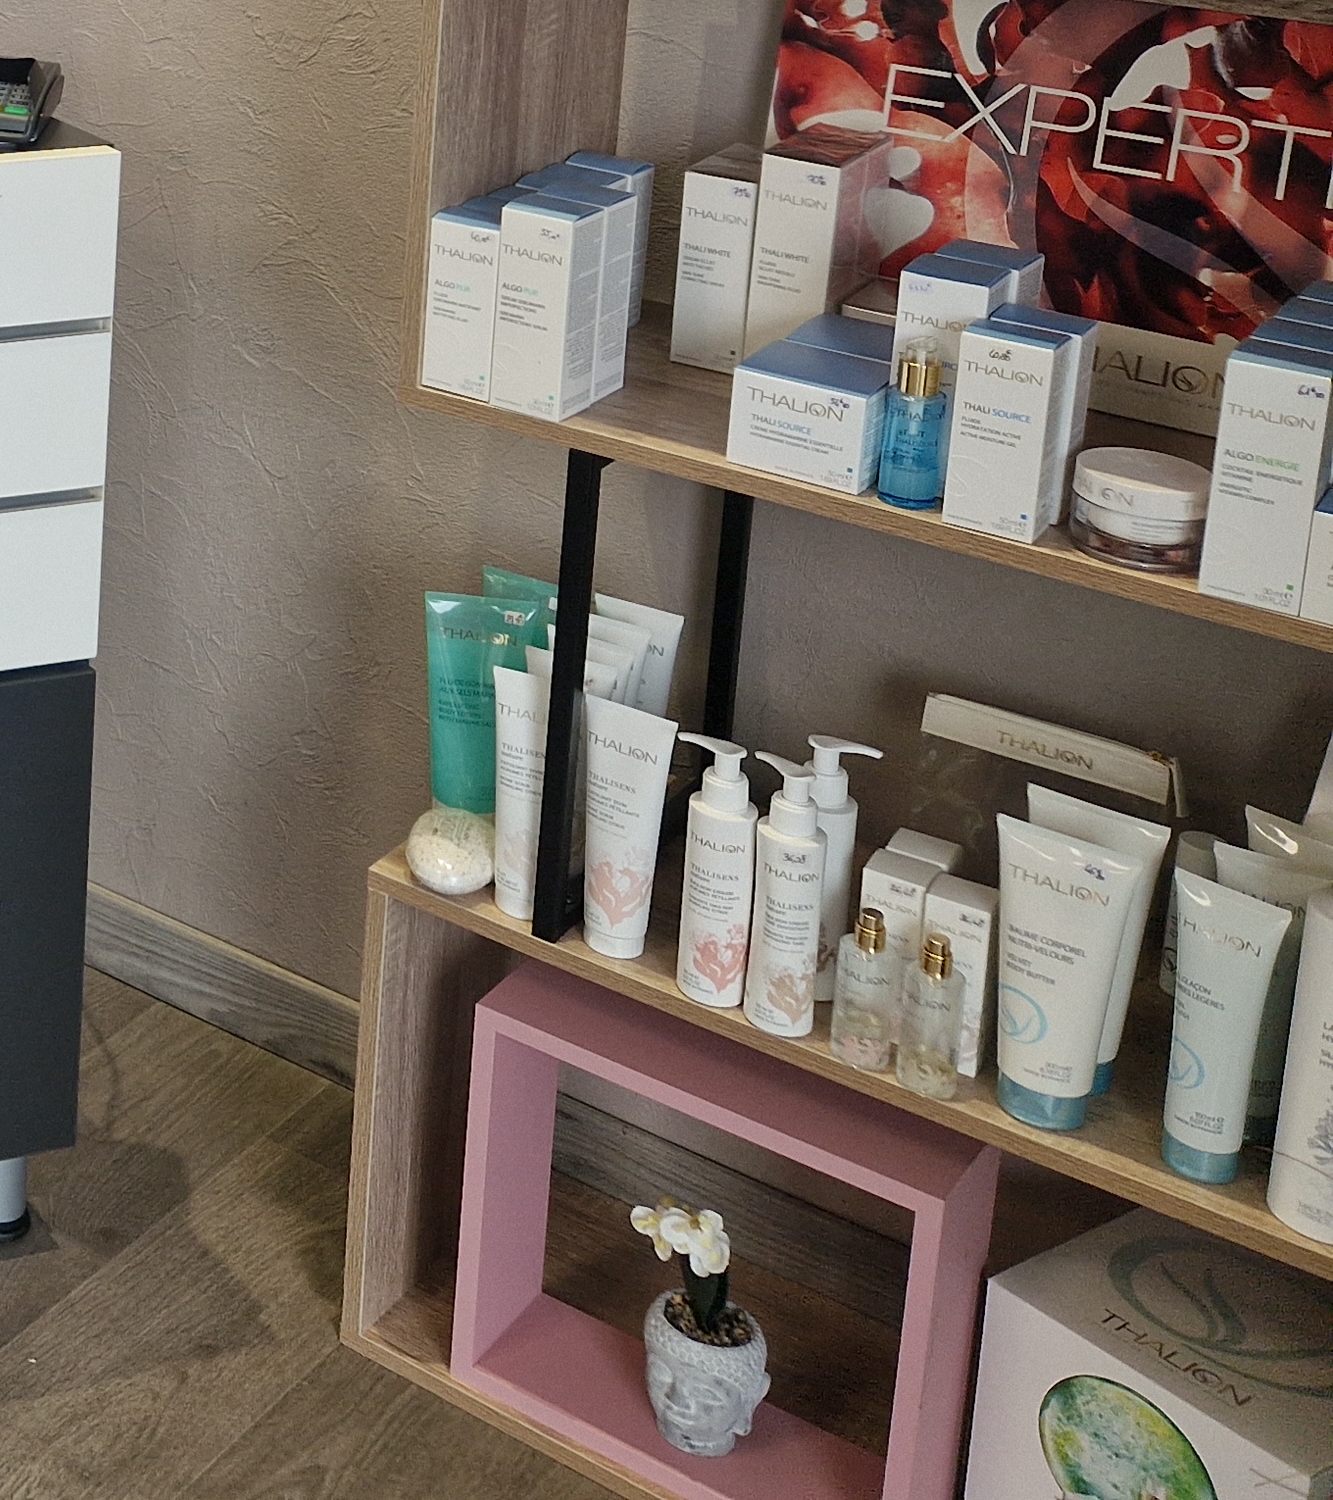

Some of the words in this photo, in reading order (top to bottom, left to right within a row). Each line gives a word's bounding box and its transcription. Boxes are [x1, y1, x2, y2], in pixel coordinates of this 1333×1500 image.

[881, 63, 1333, 210] EXPERT
[764, 189, 828, 211] THALION
[685, 205, 749, 227] THALION
[434, 243, 493, 267] THALION
[502, 242, 563, 267] THALION
[683, 242, 707, 254] THALI
[707, 247, 732, 259] WHITE
[759, 246, 785, 259] THALI
[784, 251, 810, 264] WHITE
[434, 278, 456, 289] ALGO
[501, 281, 523, 293] ALGO
[964, 359, 1045, 388] THALION
[747, 385, 844, 423] THALION
[962, 400, 991, 415] THALI
[991, 407, 1032, 424] SOURCE
[751, 413, 777, 427] THALI
[776, 419, 813, 436] SOURCE
[1226, 402, 1317, 432] THALION
[1224, 448, 1254, 462] ALGO
[1255, 456, 1301, 473] ENERGIE
[587, 730, 659, 766] THALION
[995, 729, 1095, 773] THALION
[588, 770, 637, 795] THALISENS
[690, 831, 746, 854] THALION
[762, 861, 821, 884] THALION
[1008, 862, 1111, 908] THALION
[1099, 1307, 1253, 1408] THALION
